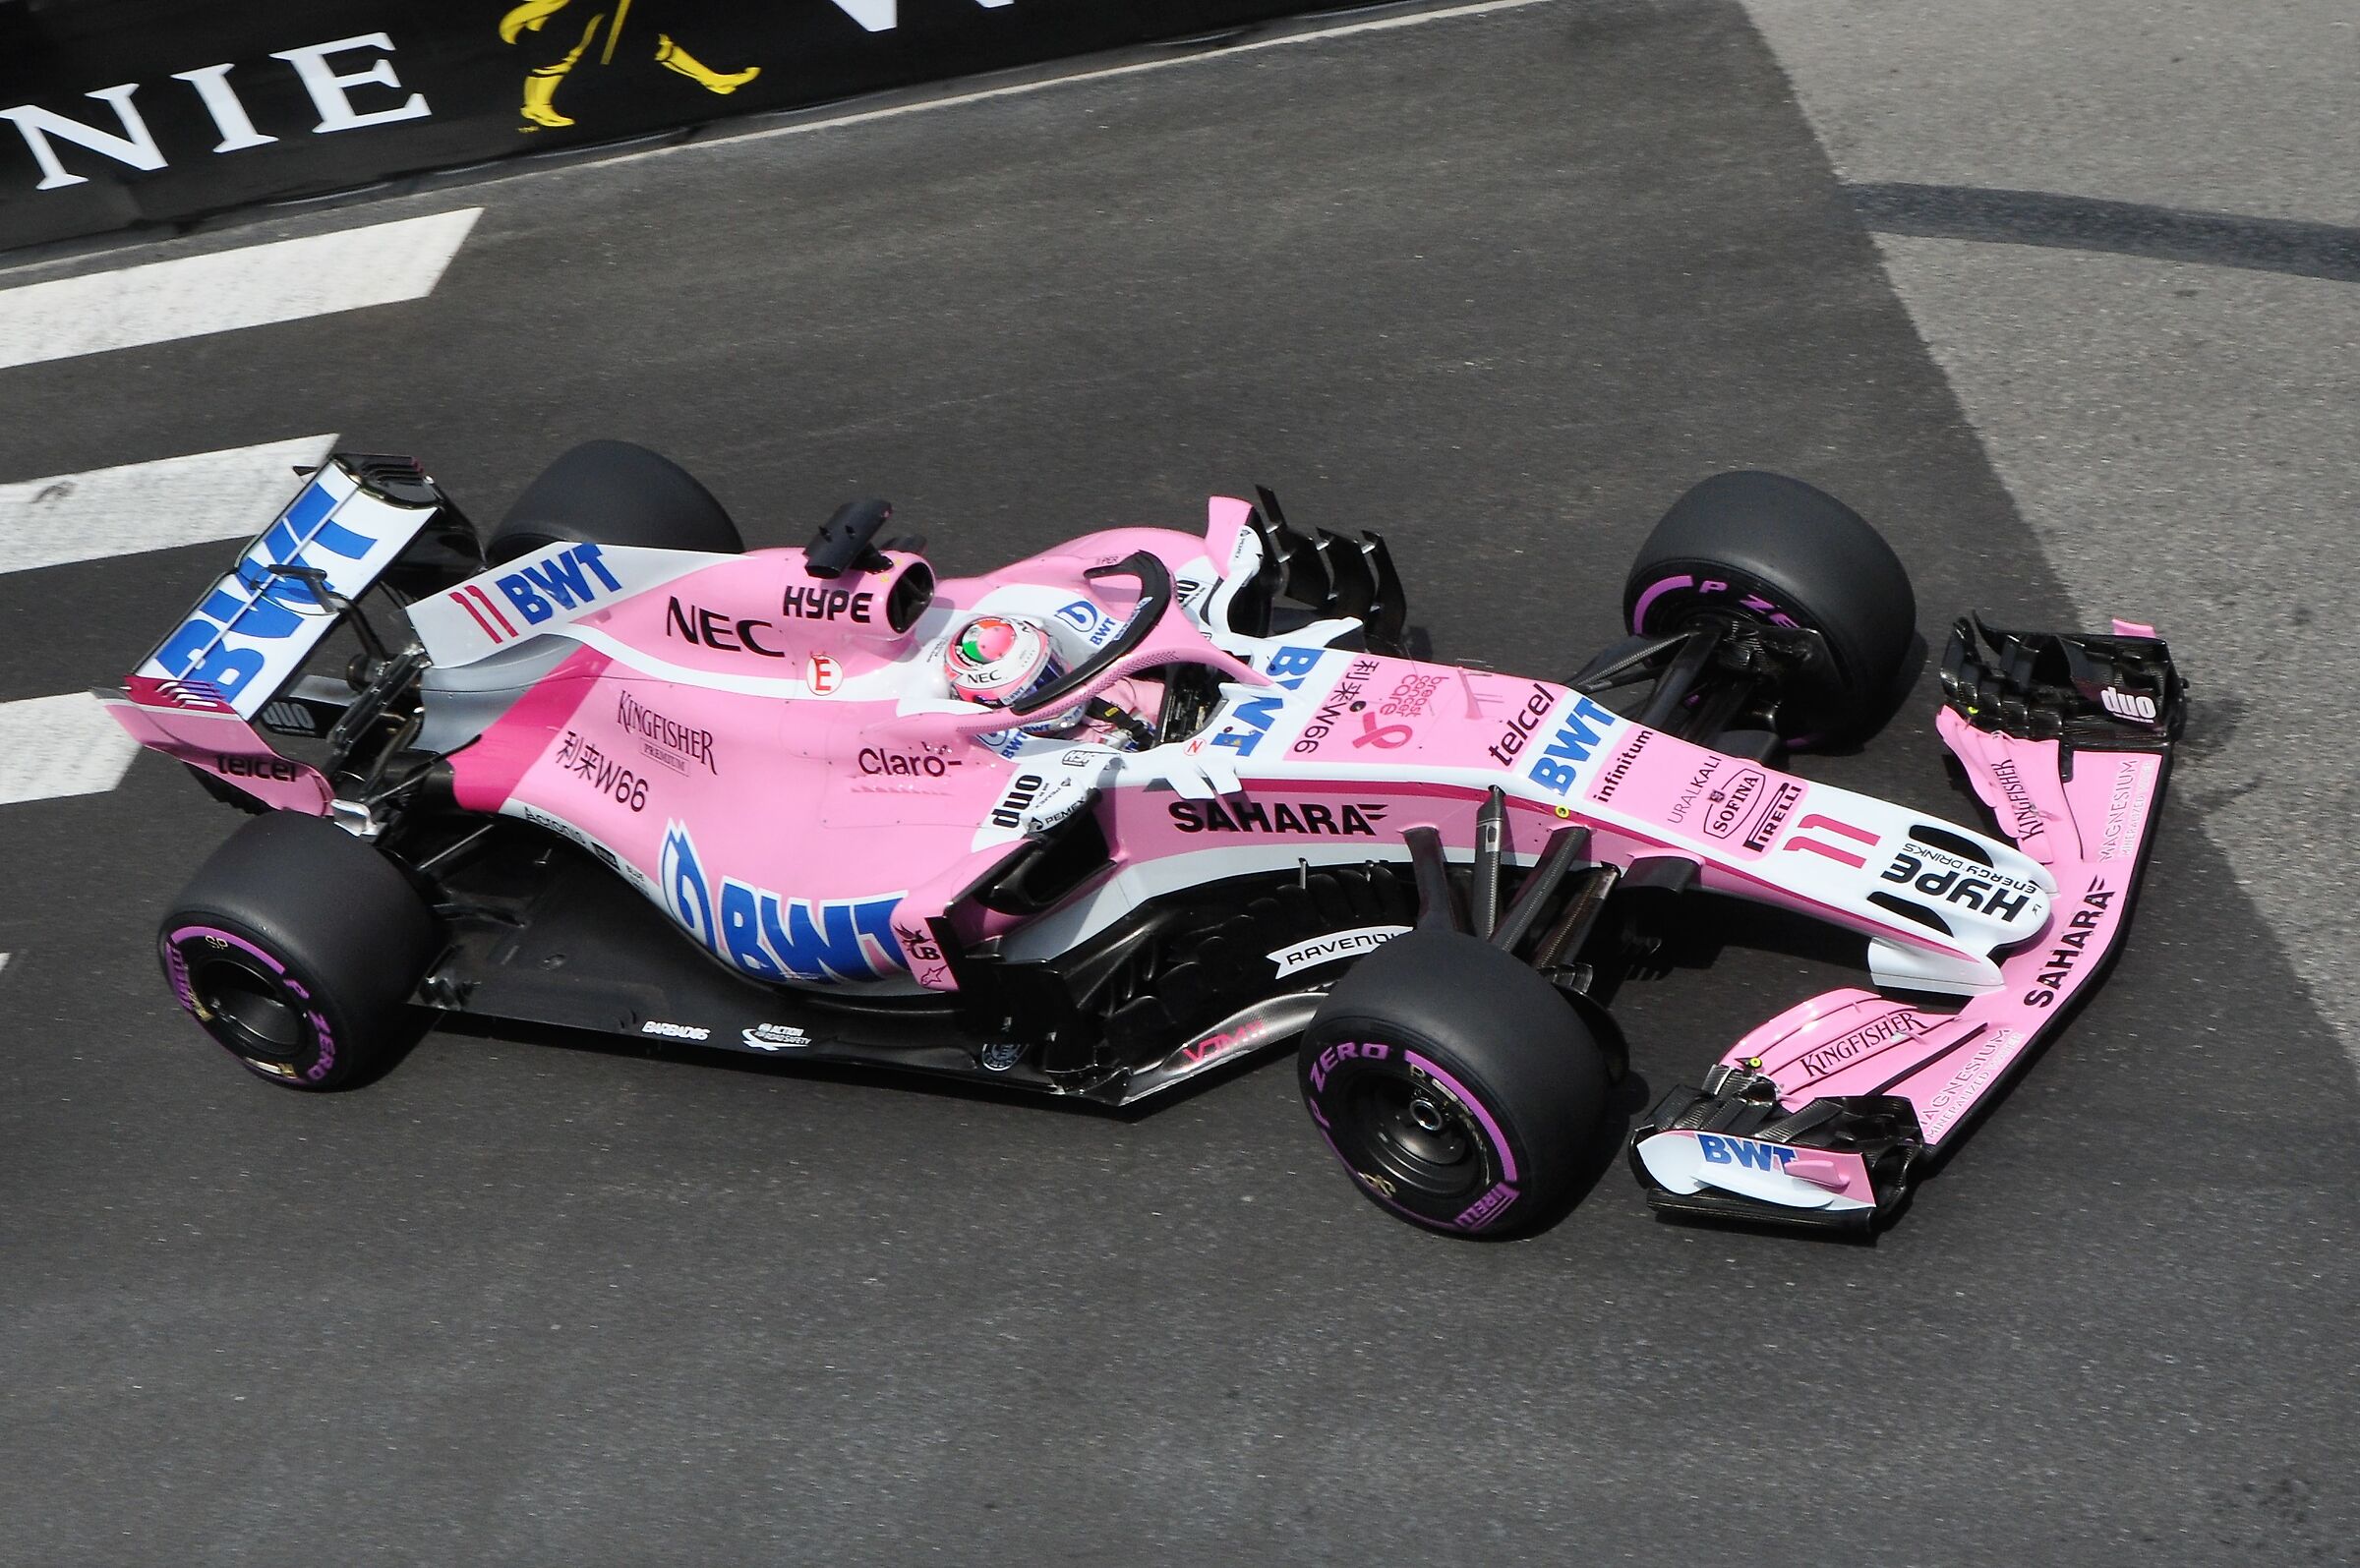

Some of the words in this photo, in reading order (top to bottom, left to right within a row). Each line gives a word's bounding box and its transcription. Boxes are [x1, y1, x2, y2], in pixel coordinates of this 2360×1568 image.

[0, 32, 432, 190] NIE
[495, 542, 622, 625] BWT
[783, 585, 874, 623] HYPE
[447, 584, 520, 644] 11
[667, 595, 786, 658] NEC
[1090, 617, 1117, 646] BWT
[967, 669, 1002, 684] NEC
[1379, 673, 1419, 716] care
[1395, 675, 1431, 718] cancer
[1405, 675, 1450, 718] breast
[2100, 686, 2156, 719] duo
[261, 701, 316, 730] duo
[618, 689, 719, 776] KINGFISHER
[1488, 682, 1555, 767] telcel
[1001, 730, 1028, 759] BWT
[1528, 696, 1617, 796] BWT
[1593, 729, 1654, 803] infinitum
[991, 774, 1042, 829] duo
[1044, 798, 1087, 825] PEMEX
[1667, 755, 1722, 824] URALKALI
[1712, 777, 1760, 833] SOFINA
[1742, 782, 1802, 853] PIRELLI
[1991, 759, 2044, 842] KINGFISHER
[2099, 760, 2139, 863] MAGNESIUM
[1168, 801, 1387, 836] SAHARA
[1783, 813, 1881, 870] 11
[1903, 842, 1964, 869] DRINKS
[1880, 853, 2030, 923] HYPE
[721, 882, 908, 984] BWT
[1286, 933, 1397, 965] RAVENO
[2023, 880, 2116, 1009] SAHARA
[1310, 1041, 1389, 1093] ZERO
[1800, 1012, 1929, 1078] KINGFISHER
[1926, 1072, 1990, 1138] MINERALIZED
[1697, 1132, 1799, 1176] BWT
